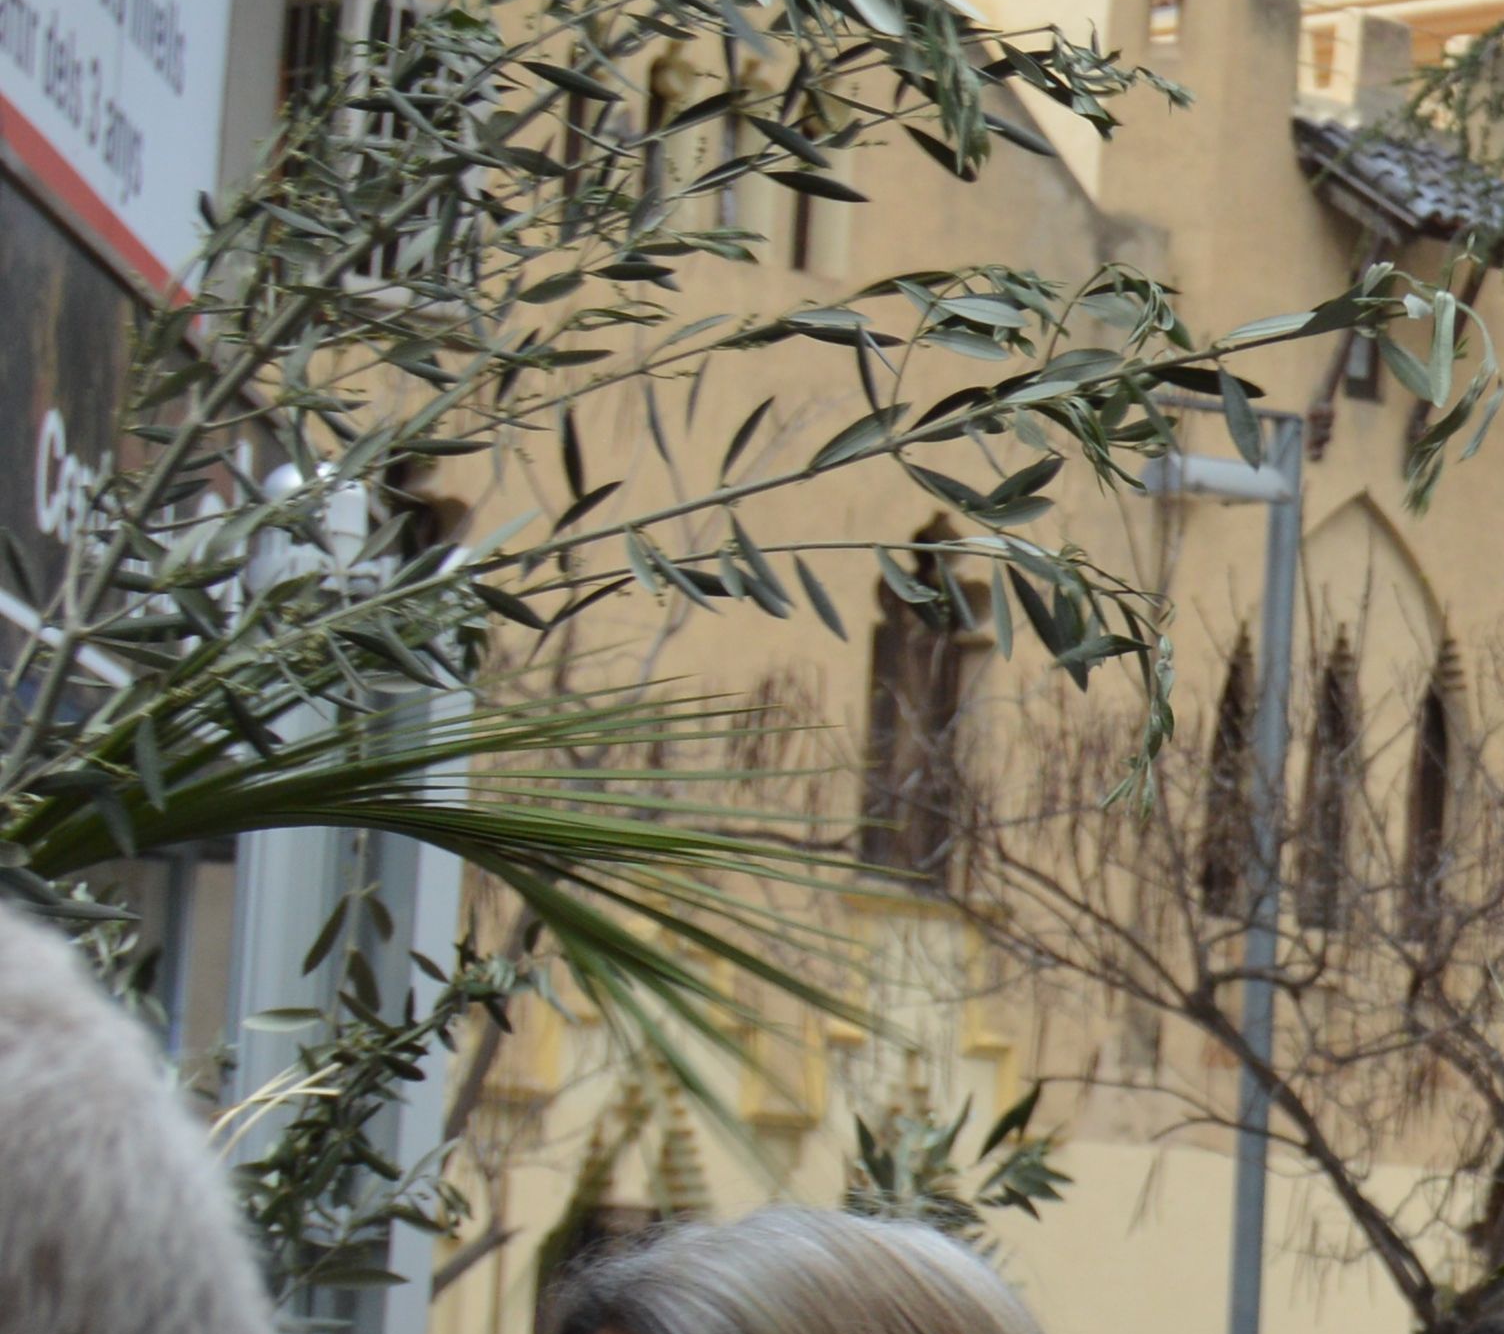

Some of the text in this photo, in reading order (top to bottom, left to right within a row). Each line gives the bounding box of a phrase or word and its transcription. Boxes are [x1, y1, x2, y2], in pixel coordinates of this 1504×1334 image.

[42, 9, 83, 130] dels
[87, 57, 102, 147] 3
[103, 98, 143, 205] anys
